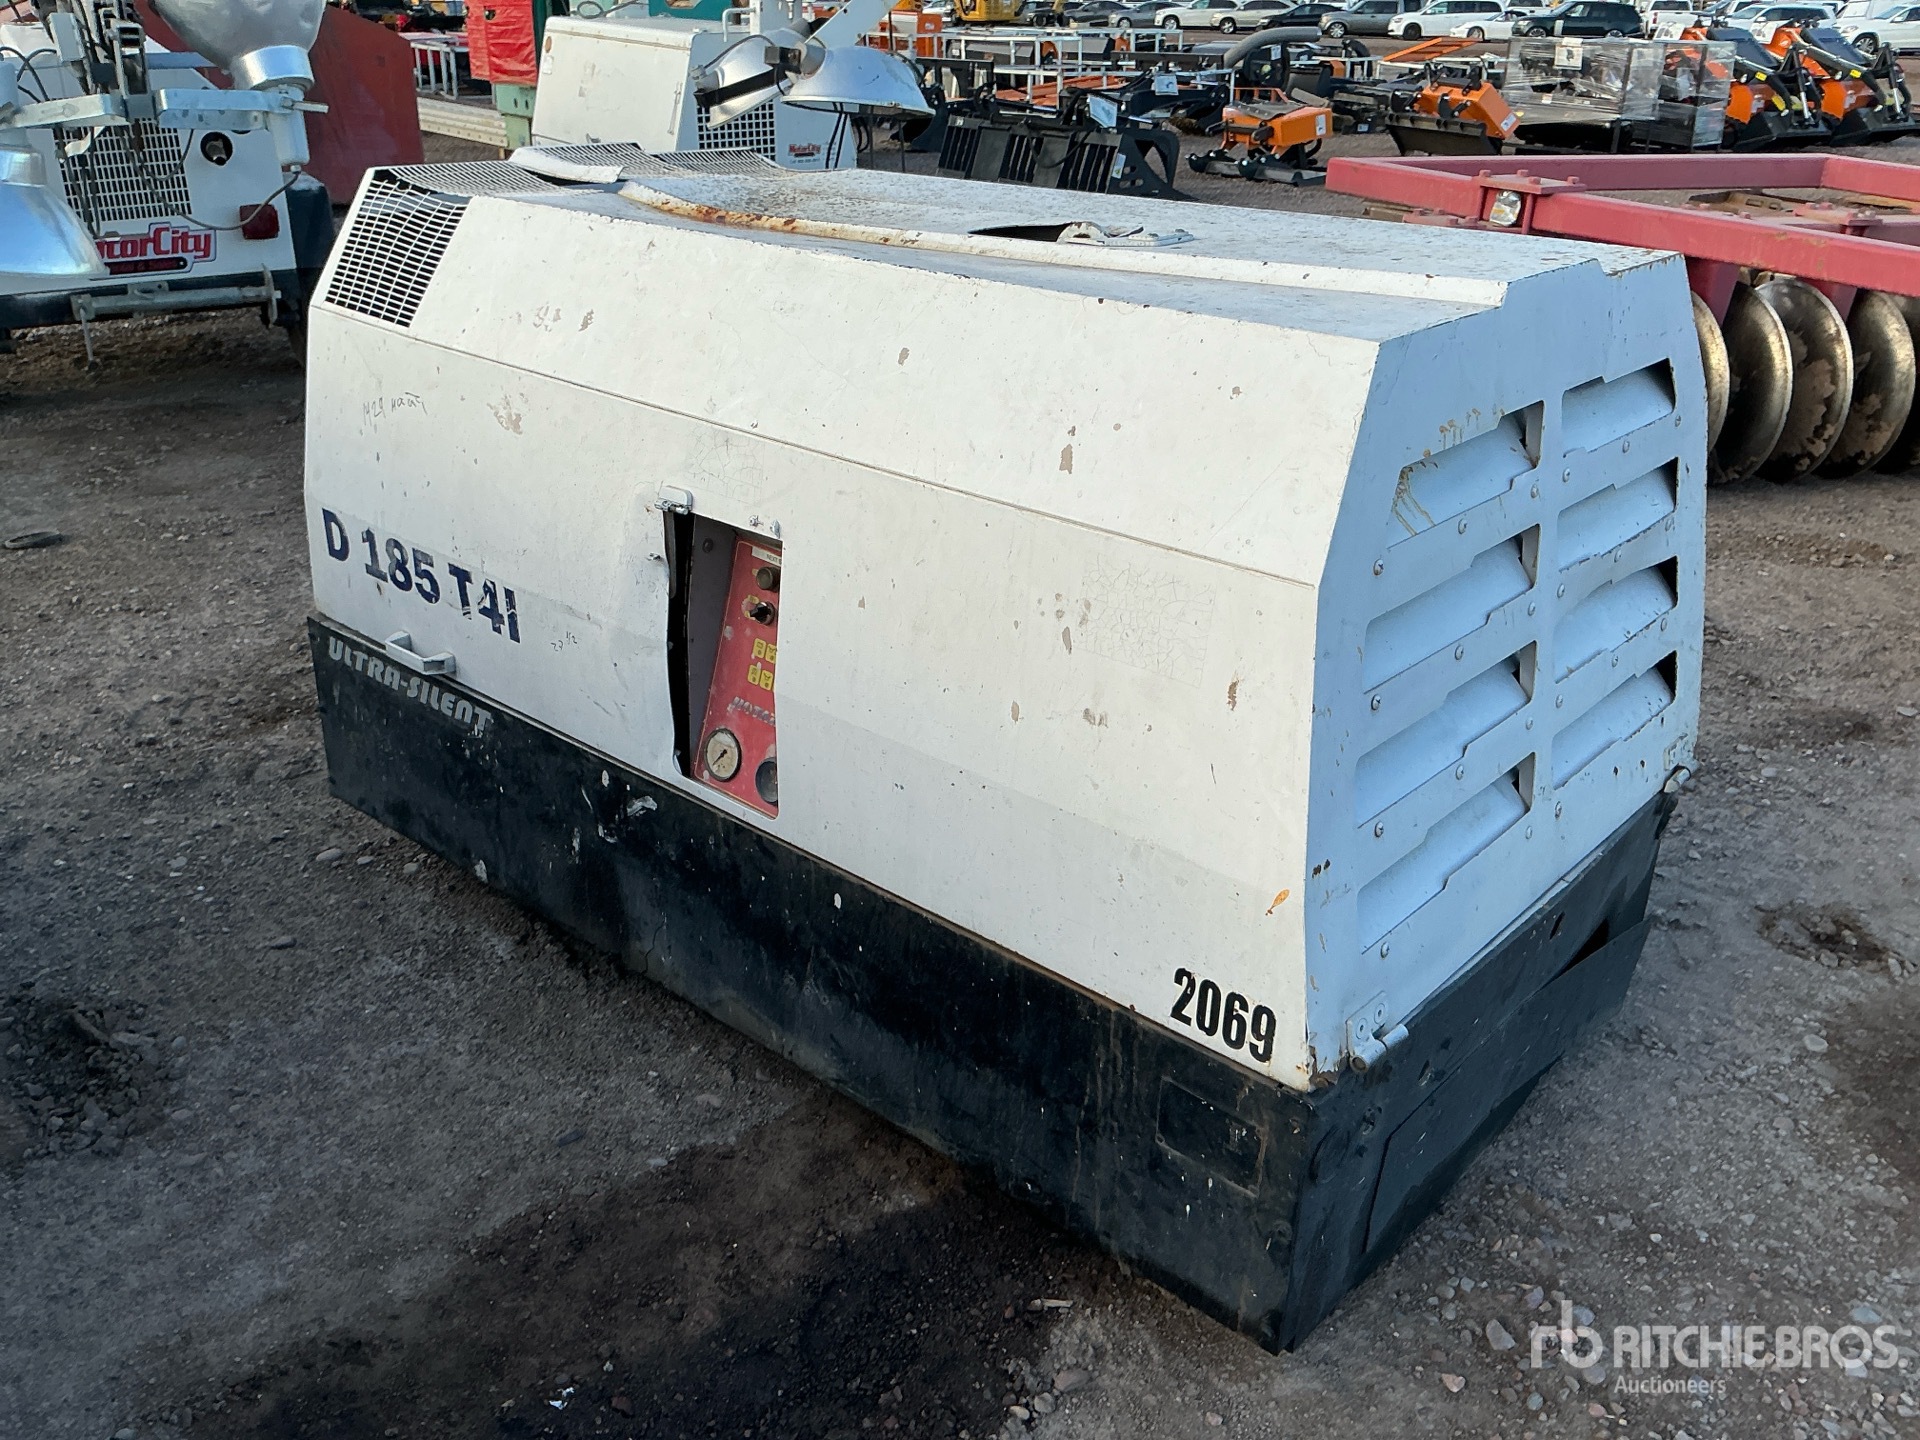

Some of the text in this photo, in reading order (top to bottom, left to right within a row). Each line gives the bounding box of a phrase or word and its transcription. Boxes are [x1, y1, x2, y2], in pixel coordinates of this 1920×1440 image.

[322, 507, 350, 562] D
[361, 527, 441, 604] 185
[328, 636, 494, 734] ULTRA-SILENT
[1170, 967, 1276, 1063] 2069
